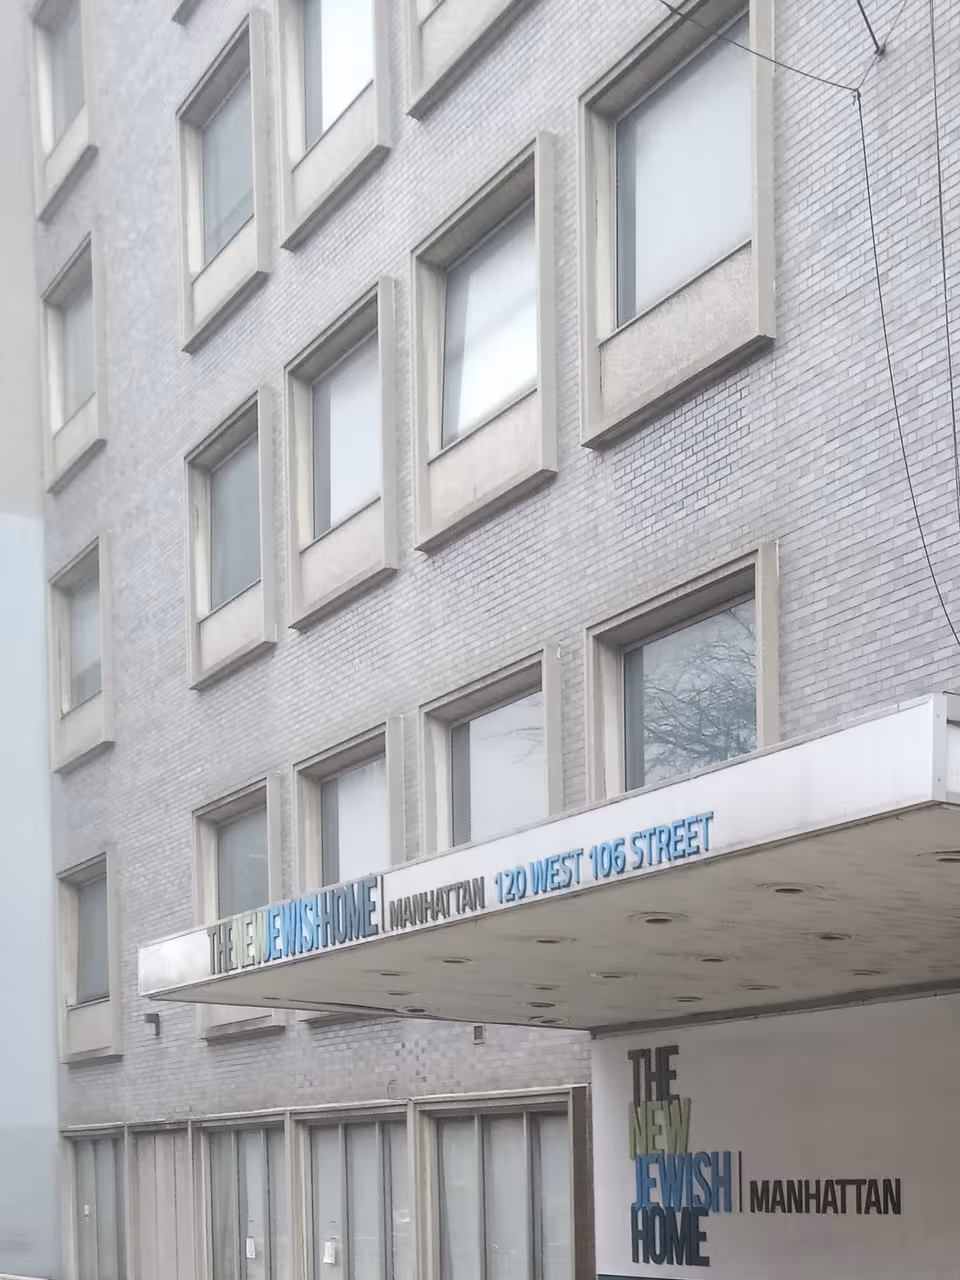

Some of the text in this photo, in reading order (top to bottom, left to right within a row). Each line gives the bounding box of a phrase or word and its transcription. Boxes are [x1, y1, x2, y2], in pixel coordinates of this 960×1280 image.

[389, 876, 486, 931] MANHATTAN
[494, 865, 527, 904] 120
[529, 848, 584, 895] WEST
[589, 837, 626, 880] 106
[629, 811, 714, 870] STREET
[627, 1043, 680, 1107] THE
[628, 1097, 692, 1161] NEW
[632, 1149, 902, 1215] JEWISH MANHATTAN
[630, 1206, 711, 1266] HOME
